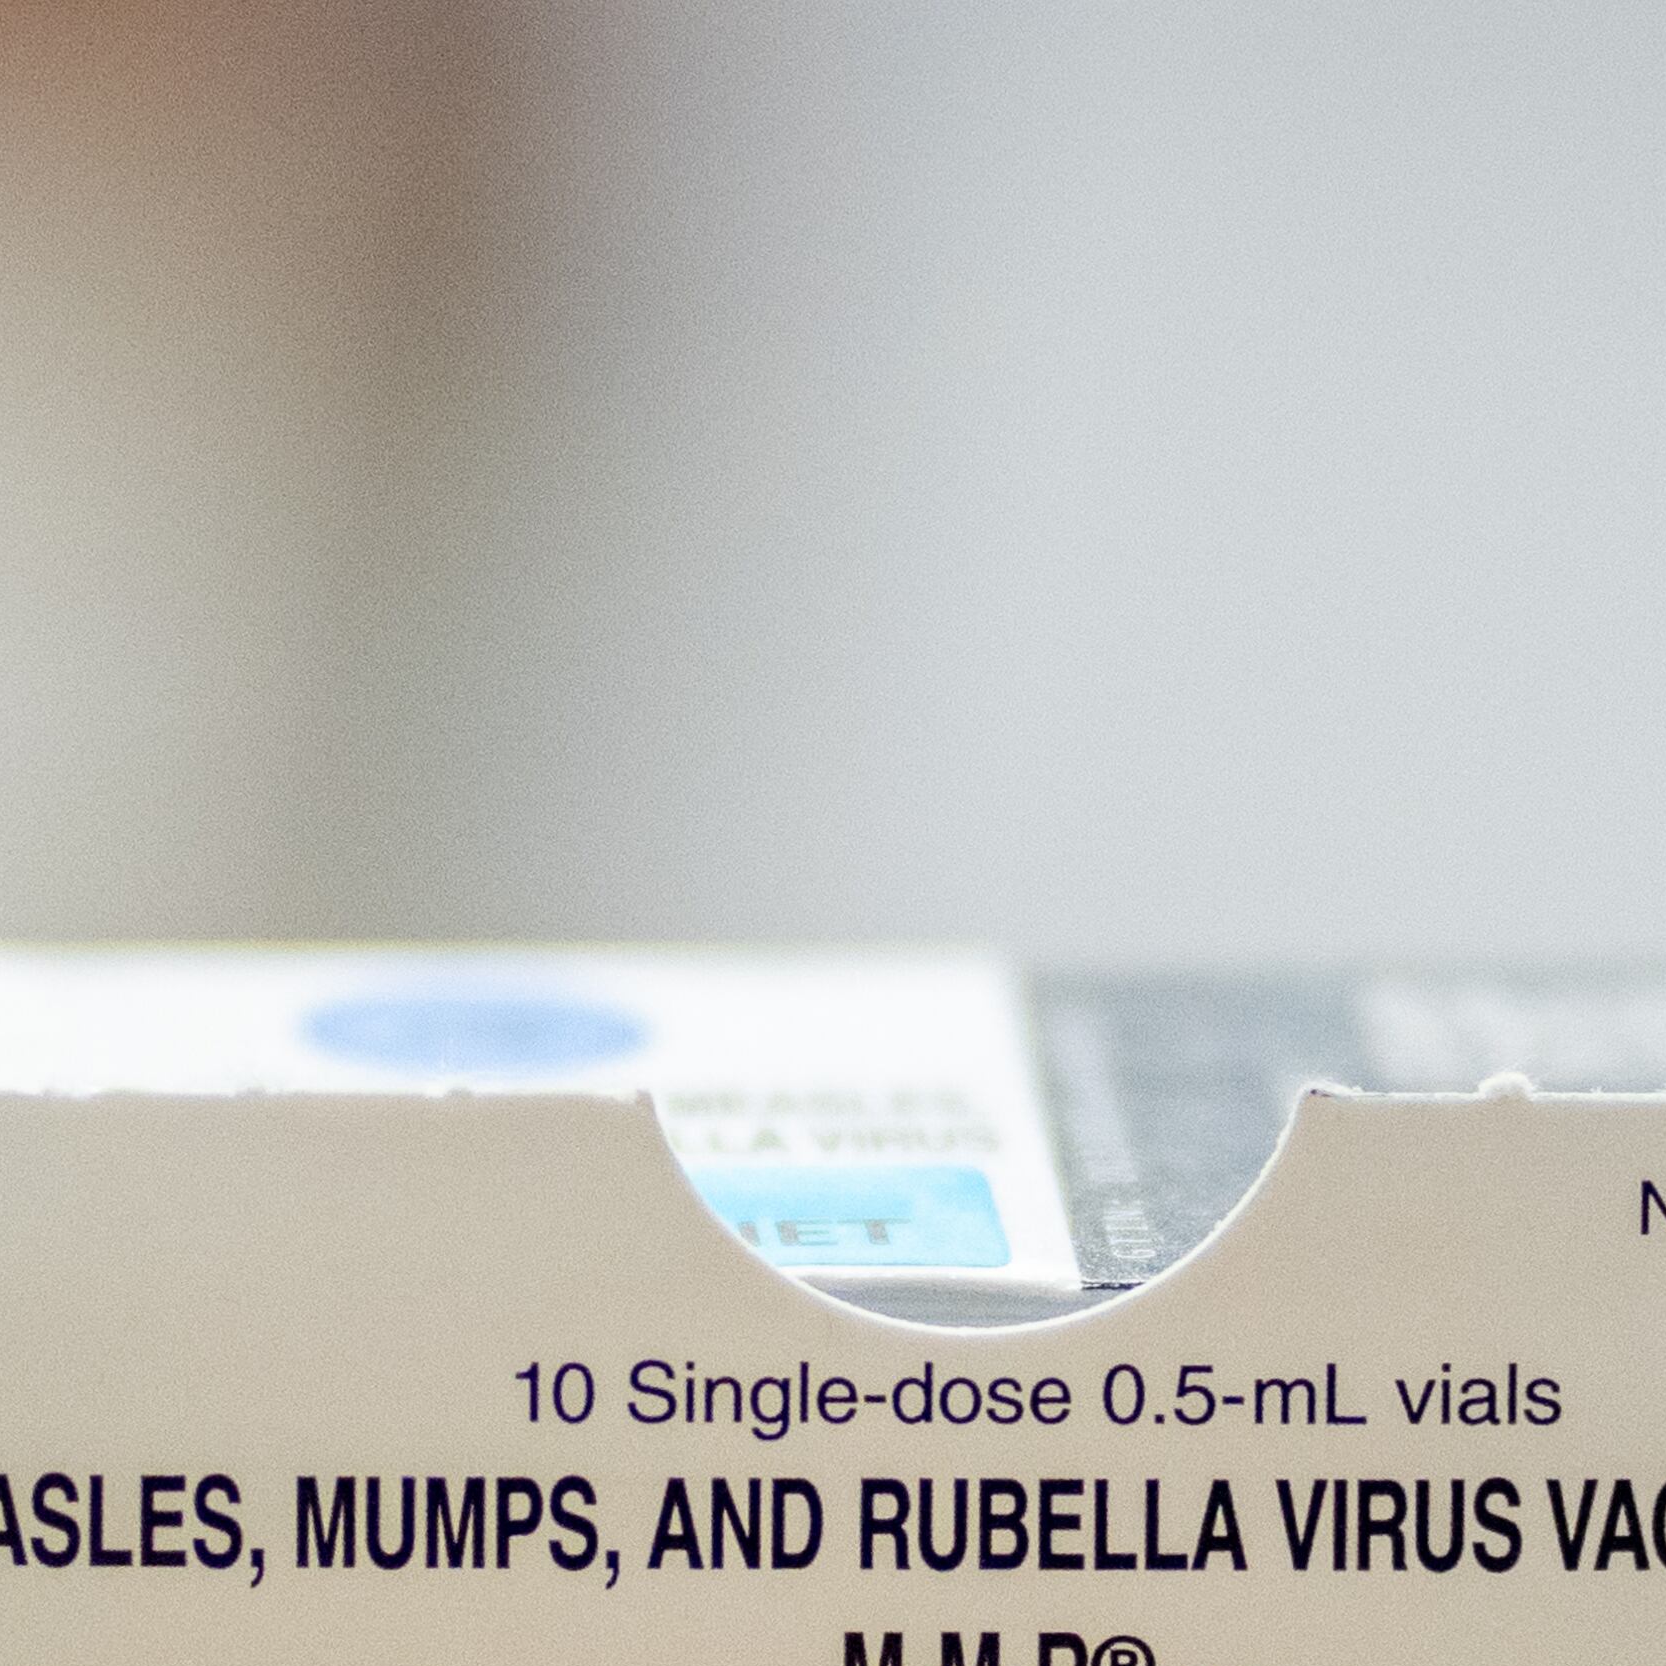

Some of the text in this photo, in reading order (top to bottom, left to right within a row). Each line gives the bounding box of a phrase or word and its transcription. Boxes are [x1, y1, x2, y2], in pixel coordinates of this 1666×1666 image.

[515, 1358, 1563, 1442] 10 Single-dose 0.5-mL vials
[295, 1474, 621, 1590] MUMPS,
[646, 1475, 825, 1572] AND
[859, 1477, 1249, 1574] RUBELLA
[1275, 1476, 1524, 1575] VIRUS
